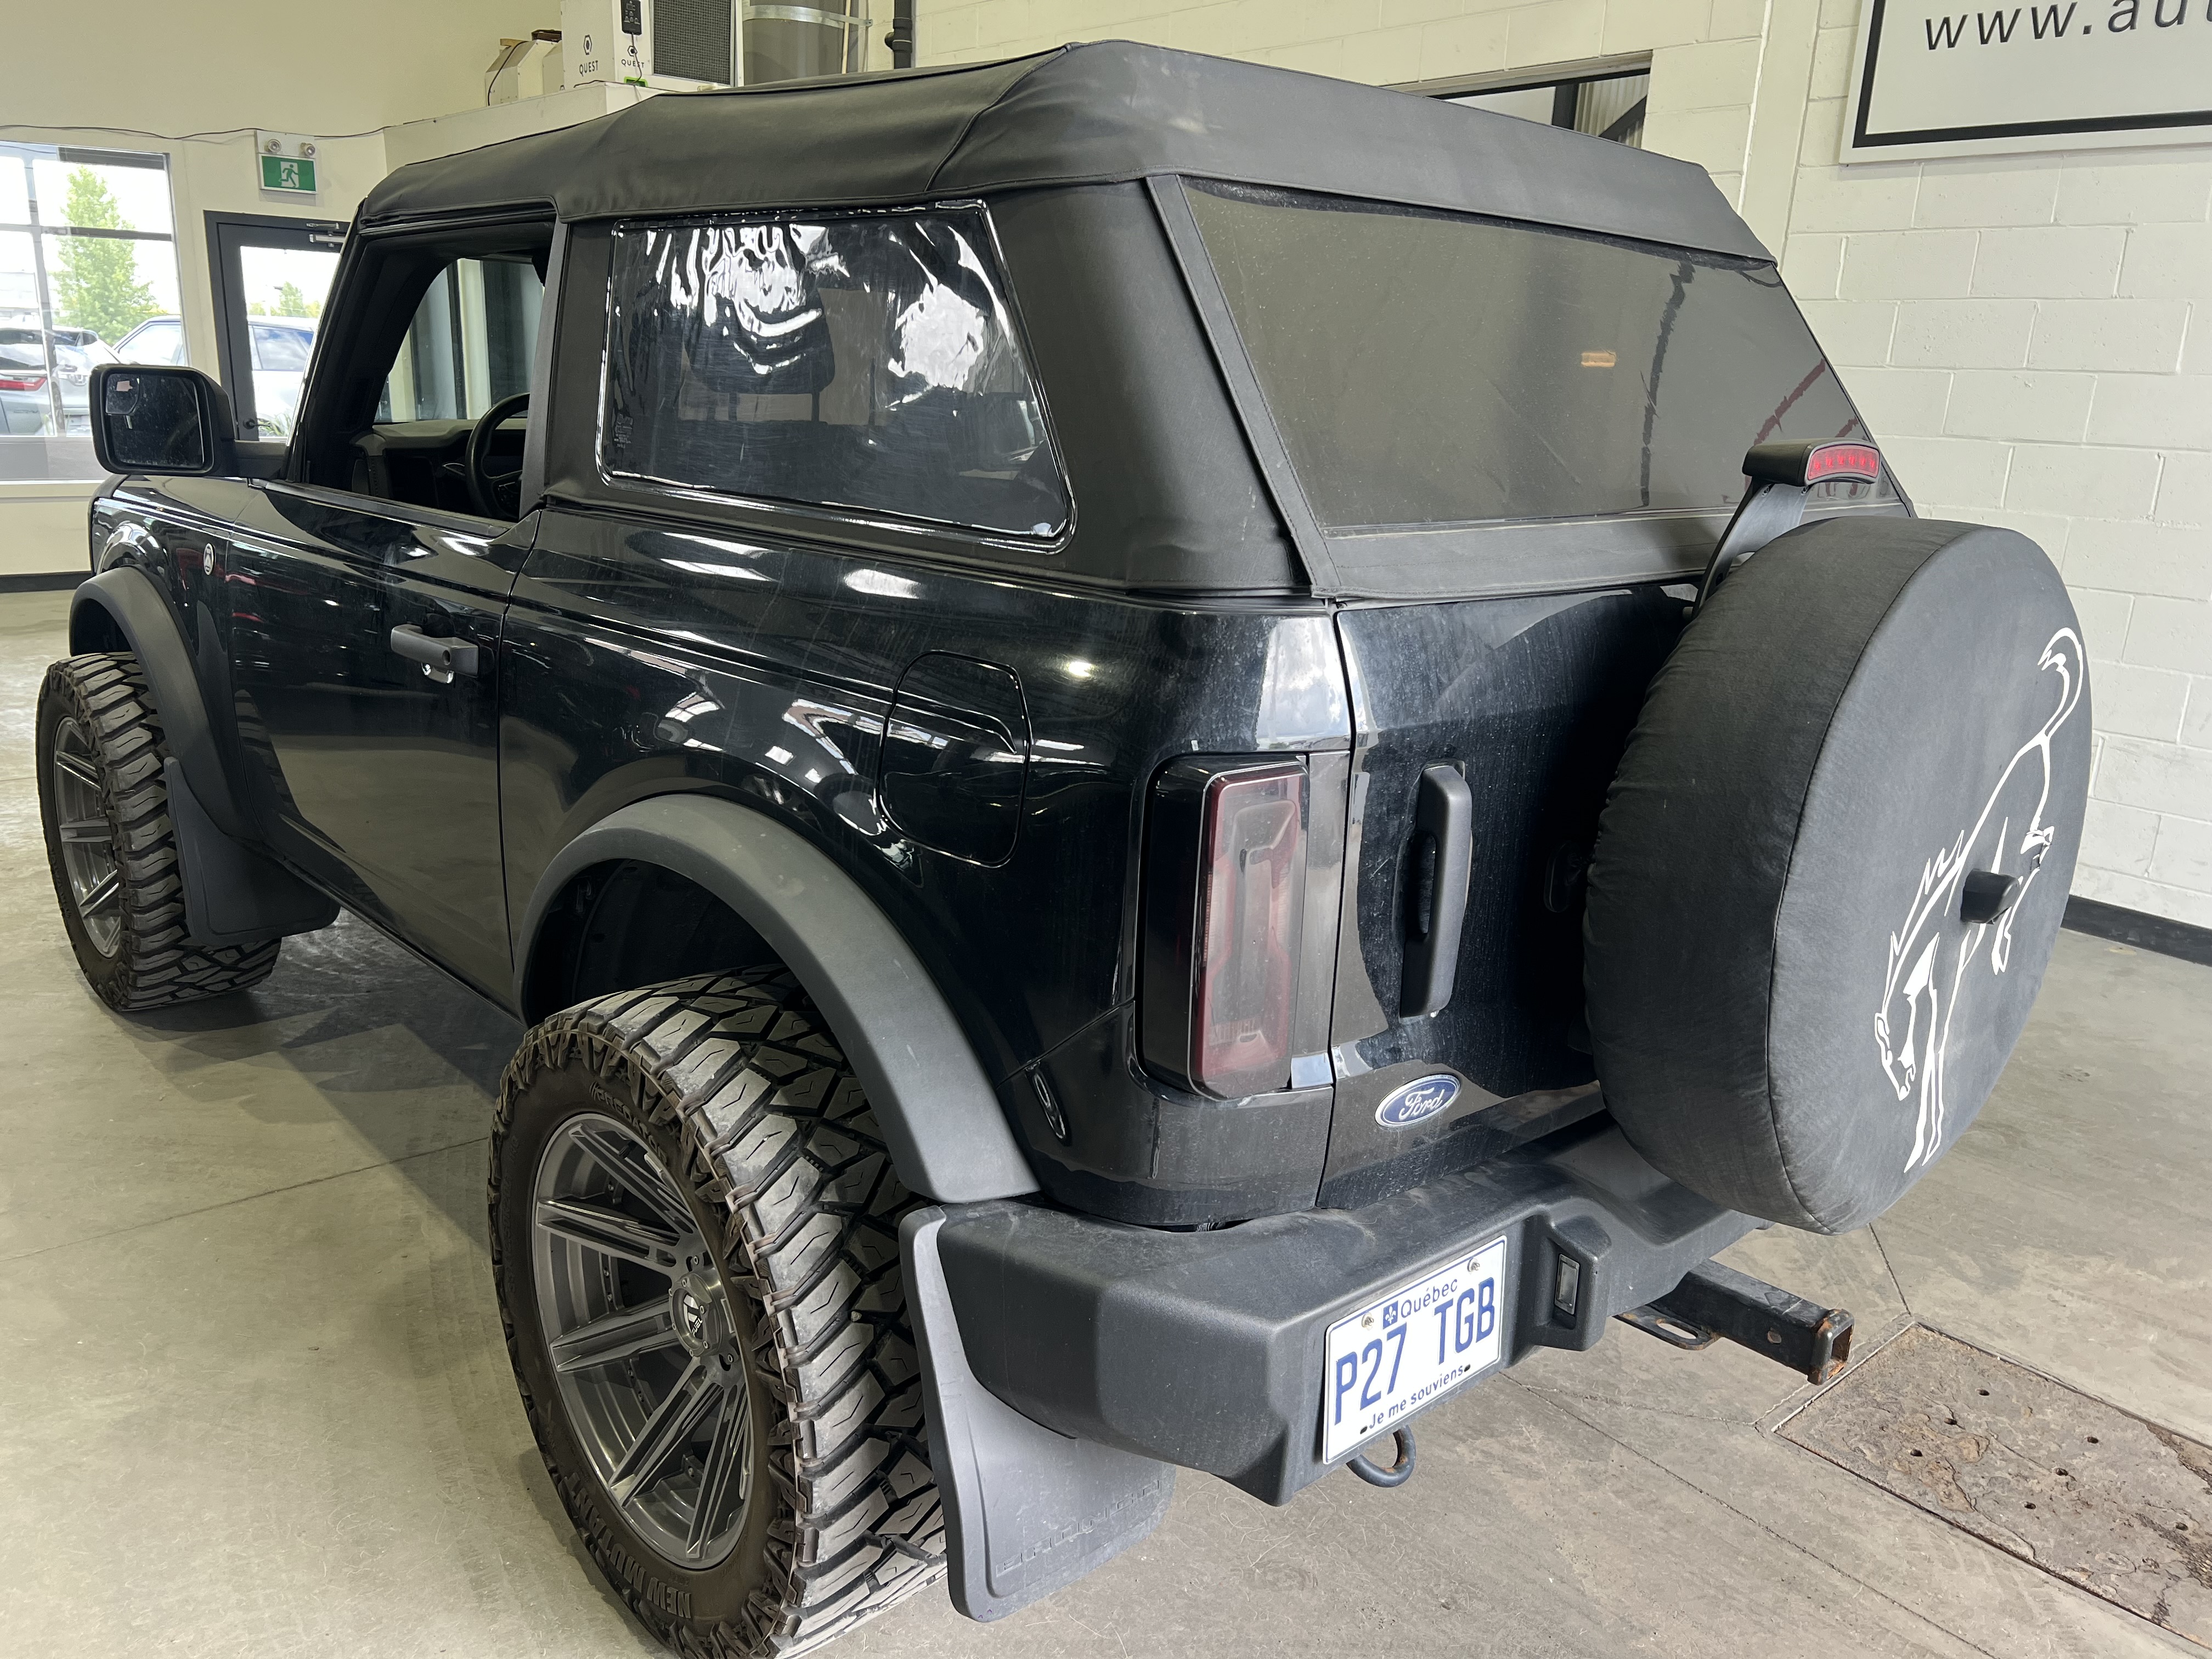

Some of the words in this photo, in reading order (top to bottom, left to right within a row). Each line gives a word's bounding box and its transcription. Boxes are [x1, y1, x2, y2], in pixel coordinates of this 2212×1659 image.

[1925, 0, 2212, 50] www.au
[579, 60, 599, 77] QUEST
[594, 1083, 668, 1165] PREDATOR
[1398, 1087, 1445, 1121] Ford
[1401, 1279, 1458, 1318] Québec
[691, 1318, 703, 1338] FUEL
[1335, 1322, 1407, 1426] P27
[1434, 1277, 1495, 1365] TGB
[1369, 1413, 1384, 1429] Je
[1389, 1400, 1407, 1418] me
[1410, 1365, 1463, 1405] souviens
[565, 1472, 647, 1593] MUTANT
[646, 1577, 691, 1618] NEW
